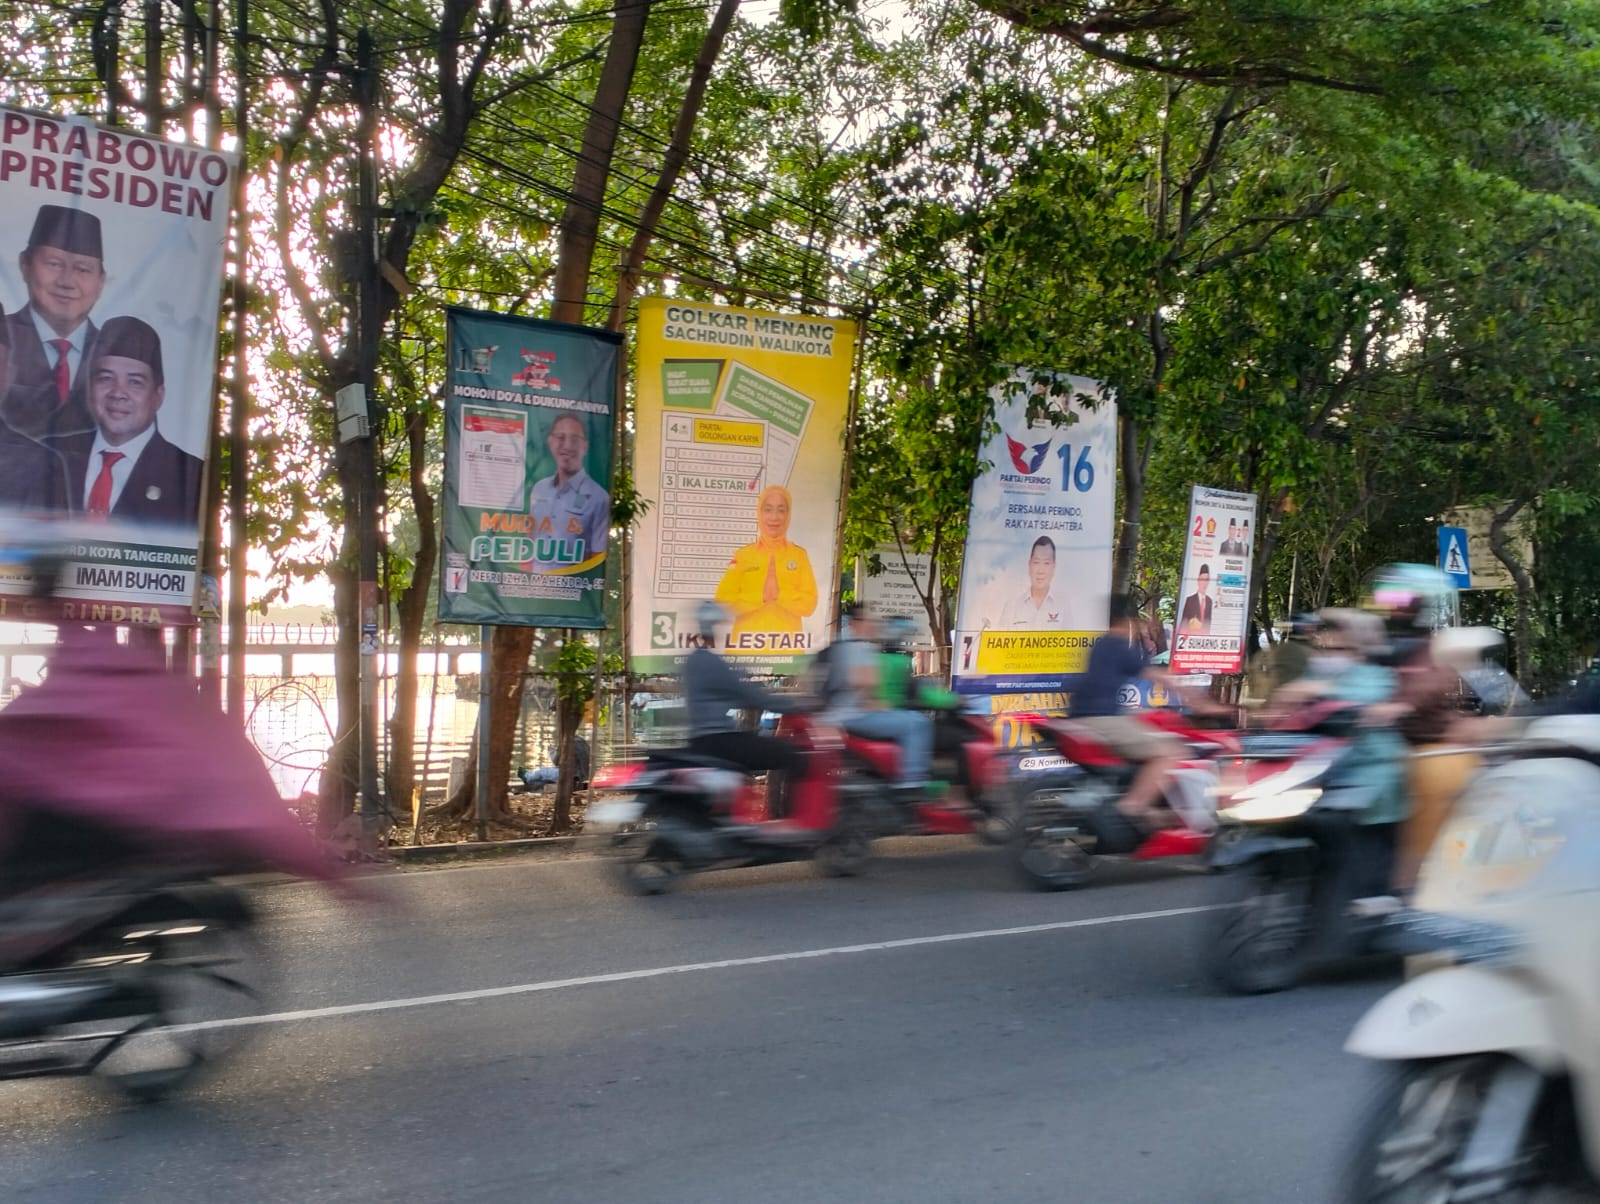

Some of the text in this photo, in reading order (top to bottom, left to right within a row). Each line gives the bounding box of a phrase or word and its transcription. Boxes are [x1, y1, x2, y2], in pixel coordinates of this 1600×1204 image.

[3, 112, 228, 187] PRABOWO
[0, 149, 214, 221] PRESIDEN
[667, 307, 835, 340] GOLKAR MENANG
[665, 325, 833, 357] SACHRUDIN WALIKOTA
[454, 385, 494, 399] MOHON
[670, 423, 678, 433] 4
[698, 423, 721, 431] PARTAI
[698, 431, 737, 442] GOLONGAN
[1057, 443, 1094, 492] 16
[666, 476, 747, 491] 3 IKA LESTARI
[1000, 475, 1052, 485] PARTAI PERINDO
[1008, 504, 1046, 516] BERSAMA
[480, 512, 583, 535] MUDA &
[1005, 518, 1083, 532] RAKYAT SEJAHTERA
[1193, 515, 1203, 537] 2
[90, 547, 122, 561] KOTA
[123, 550, 197, 566] TANGERANG
[470, 535, 586, 564] PEDULI
[77, 568, 186, 592] IMAM BUHORI
[22, 600, 162, 625] GRINDRA
[654, 614, 674, 646] 3
[725, 632, 812, 649] LESTARI
[986, 635, 1017, 649] HARY
[1177, 637, 1186, 650] 2
[991, 691, 1072, 713] DIRGAHAY
[1117, 688, 1139, 704] 52
[1024, 759, 1036, 768] 29
